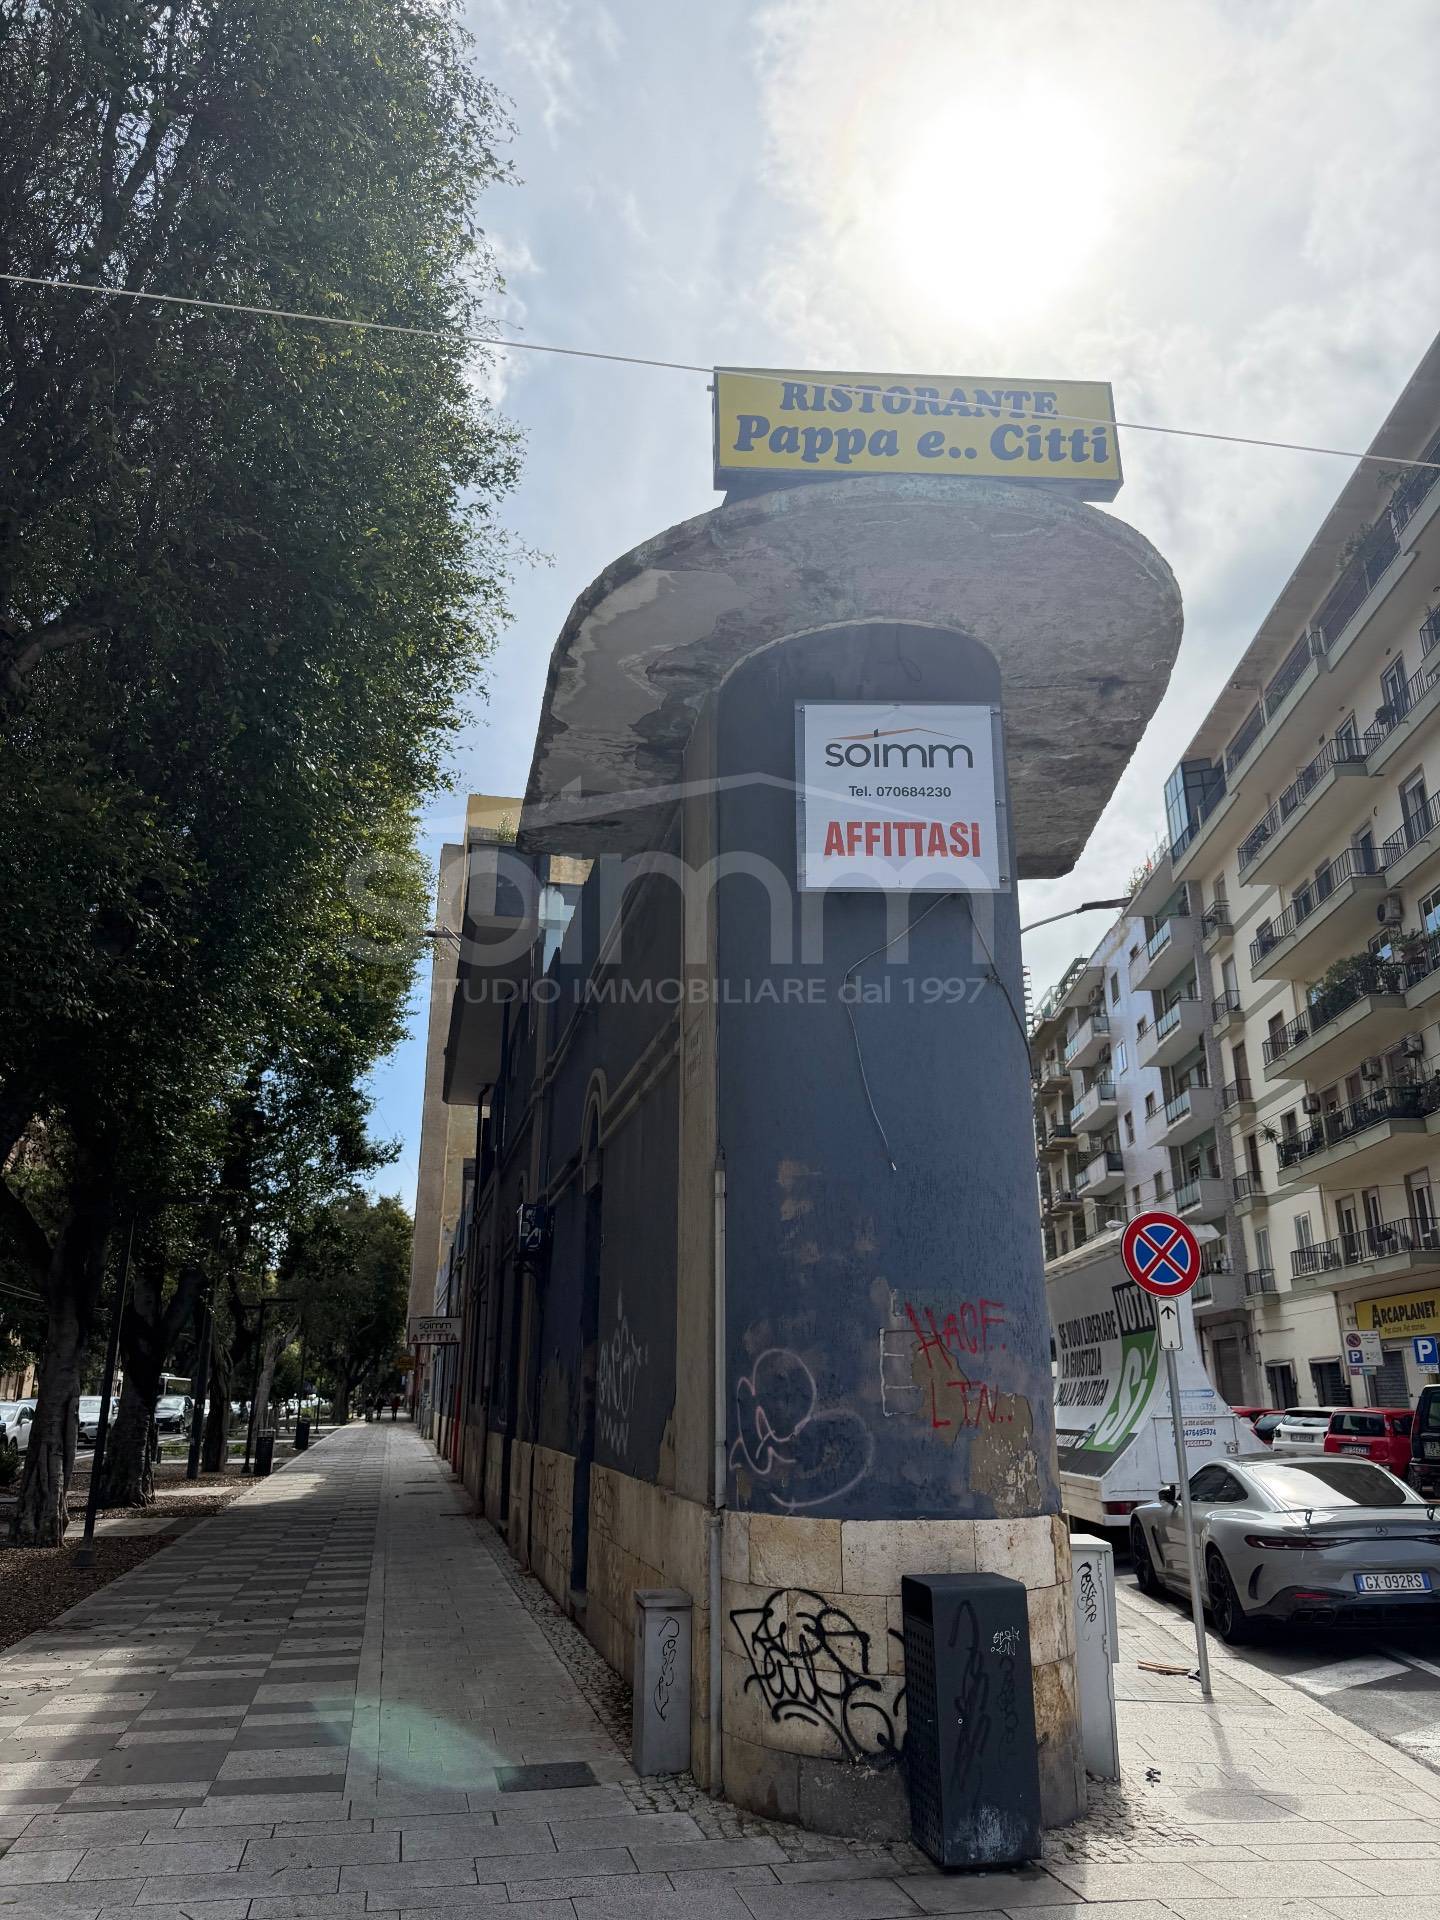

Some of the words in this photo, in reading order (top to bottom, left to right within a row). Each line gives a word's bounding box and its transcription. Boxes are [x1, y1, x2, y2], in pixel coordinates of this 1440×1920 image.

[780, 381, 1058, 419] RISTORANTE
[733, 414, 900, 464] Pappa
[917, 429, 978, 460] e..
[990, 423, 1110, 463] Citti
[825, 742, 974, 768] soimm
[848, 785, 872, 797] Tel.
[876, 785, 952, 798] 070684230
[824, 820, 981, 857] AFFITTASI
[1114, 1285, 1154, 1332] VOTA
[1058, 1323, 1068, 1349] SE
[1083, 1310, 1118, 1345] LIBERARE
[1070, 1347, 1102, 1378] GIUSTIZIA
[1351, 1351, 1360, 1362] P
[1417, 1339, 1433, 1362] P
[1365, 1575, 1381, 1589] GX
[1383, 1574, 1422, 1589] 092RS
